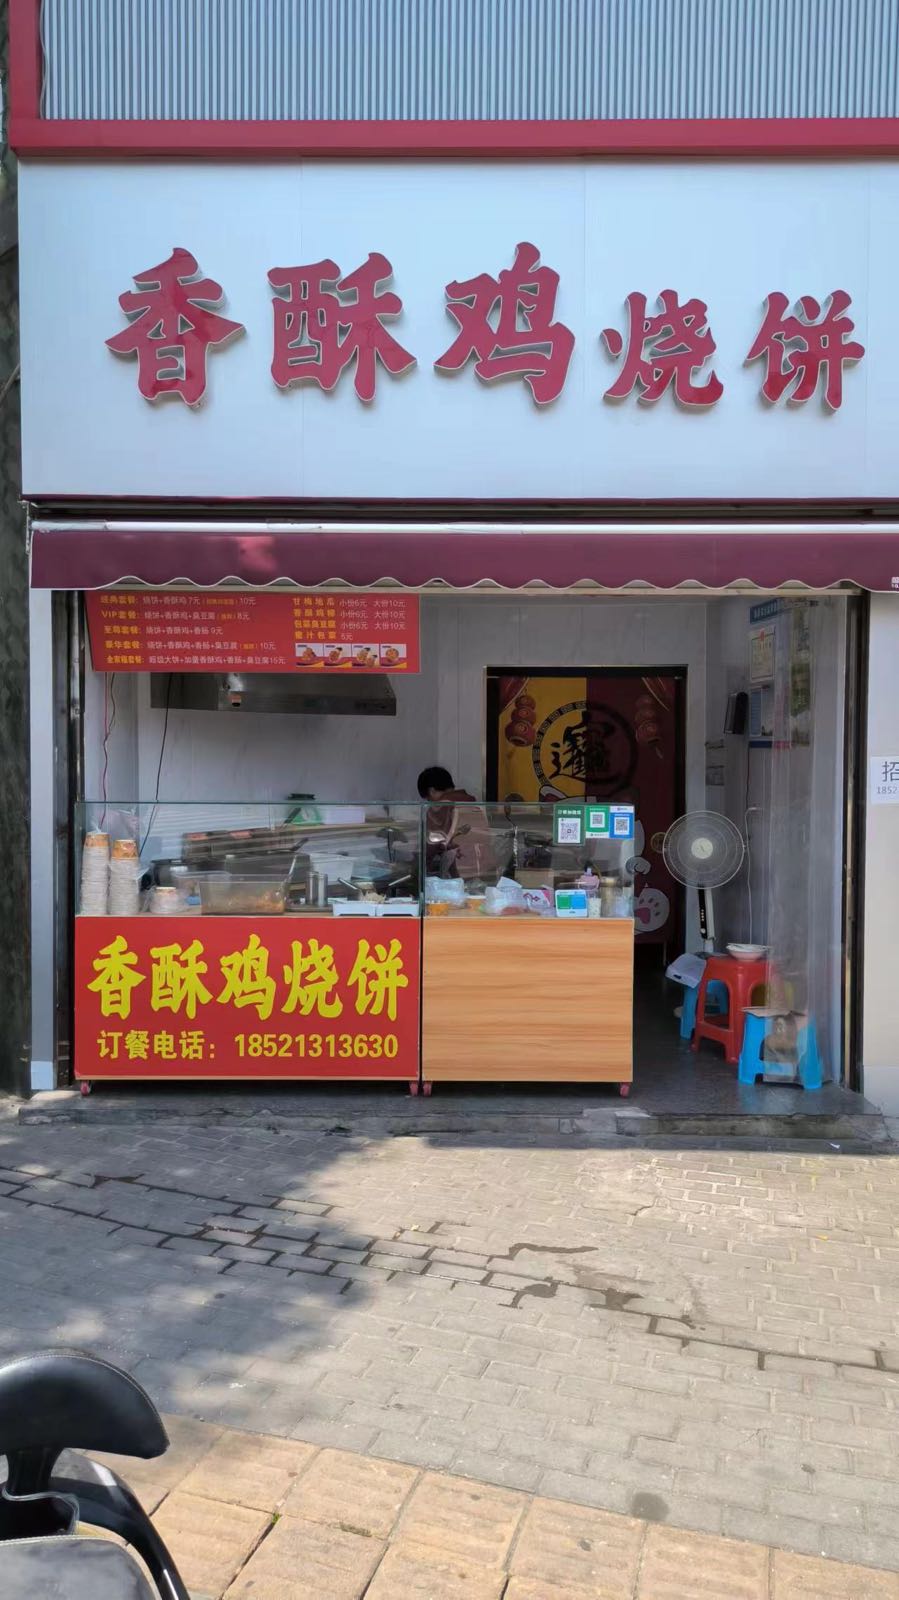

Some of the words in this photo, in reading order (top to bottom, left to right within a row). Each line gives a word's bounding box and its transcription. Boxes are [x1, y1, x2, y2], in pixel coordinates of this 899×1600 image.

[105, 241, 866, 411] 香酥鸡烧饼
[87, 933, 409, 1021] 香酥鸡烧饼
[97, 1030, 216, 1060] 订餐电话：
[235, 1033, 399, 1058] 18521313630
